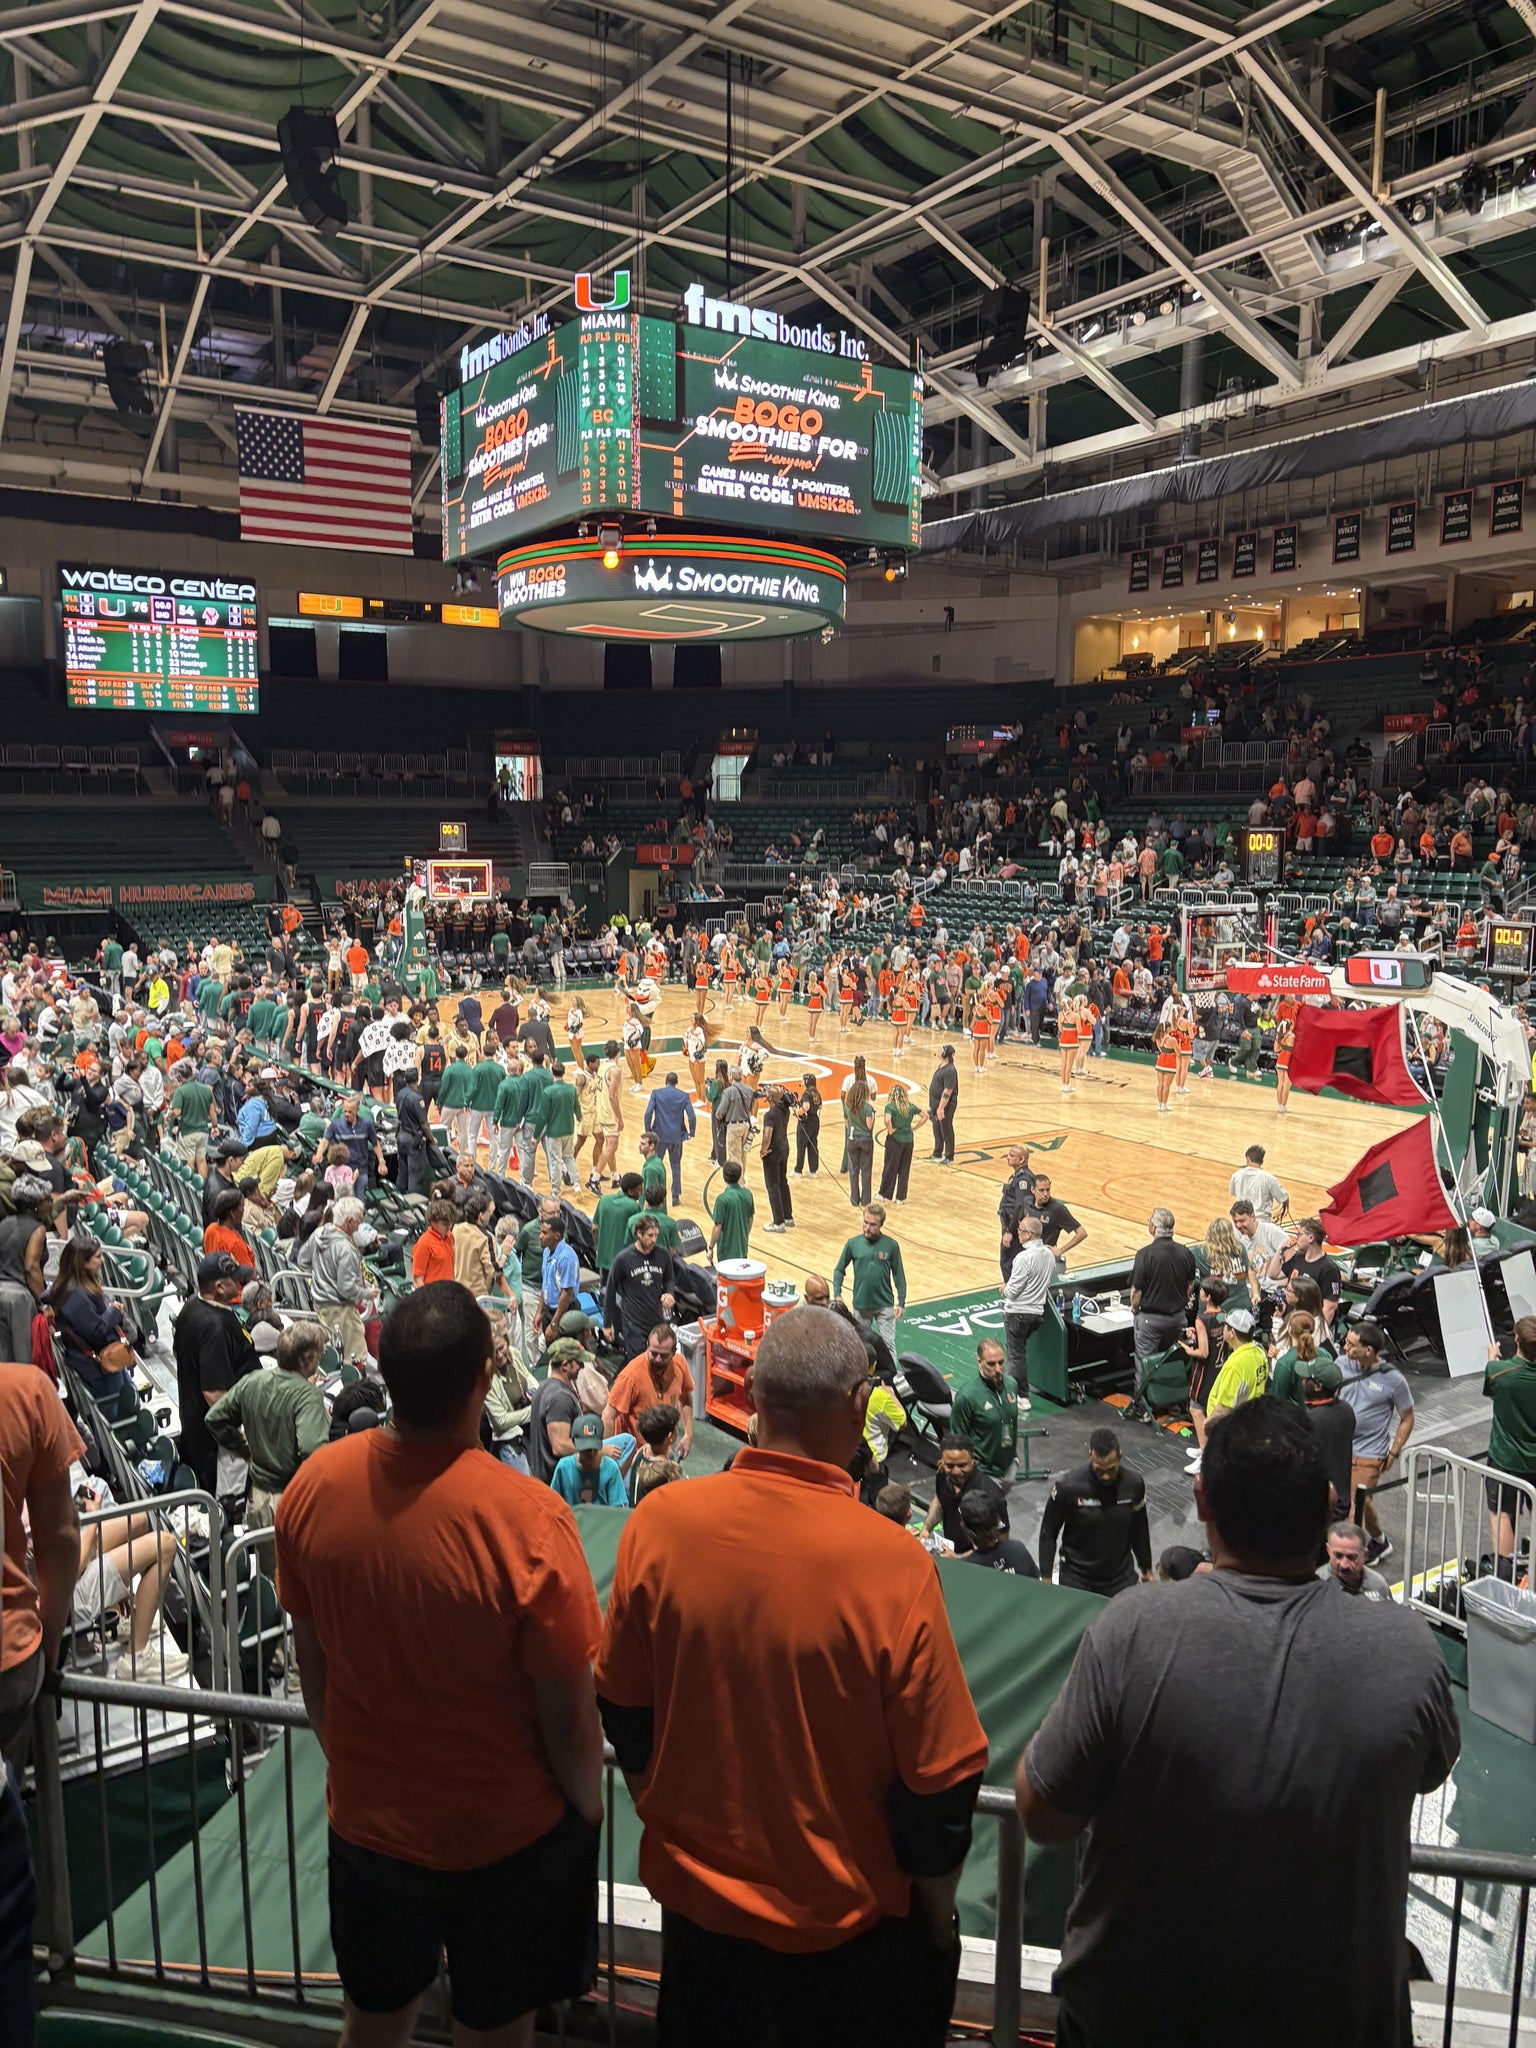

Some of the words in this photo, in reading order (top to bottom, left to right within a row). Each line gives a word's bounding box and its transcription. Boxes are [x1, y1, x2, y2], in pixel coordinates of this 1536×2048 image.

[574, 270, 631, 311] U
[533, 313, 551, 341] Inc.
[581, 313, 625, 331] MIAMI
[614, 332, 631, 343] PTS
[839, 329, 870, 361] Inc.
[599, 343, 604, 354] 1
[617, 344, 625, 354] 0
[617, 357, 626, 367] 11
[618, 370, 625, 380] 2
[598, 382, 606, 393] 0
[616, 383, 627, 393] 12
[739, 375, 806, 403] SMOOTHIE
[488, 392, 519, 418] SMOOTHIE
[617, 395, 626, 406] 4
[592, 408, 614, 424] BC
[734, 396, 823, 436] BOGO
[485, 407, 528, 453] BOGO
[615, 427, 631, 439] PTS
[599, 440, 606, 450] 2
[617, 440, 626, 451] 11
[695, 415, 811, 452] SMOOTHIES
[817, 436, 858, 461] FOR
[468, 435, 523, 478] SMOOTHIES
[525, 423, 548, 451] FOR
[599, 453, 606, 463] 0
[618, 454, 625, 464] 2
[600, 467, 606, 477] 2
[618, 467, 625, 477] 0
[701, 464, 737, 480] CANES
[739, 470, 769, 485] MADE
[772, 475, 788, 488] SIX
[617, 480, 626, 490] 11
[697, 477, 746, 499] ENTER
[749, 485, 794, 506] CODE:
[472, 498, 488, 513] CANES
[488, 492, 503, 506] MADE
[599, 493, 606, 503] 2
[470, 508, 493, 528] ENTER
[493, 499, 515, 518] CODE:
[516, 485, 548, 509] UMSK26
[1447, 504, 1468, 514] NCAA
[1391, 514, 1413, 525] WNIT
[1337, 525, 1358, 535] WNIT
[510, 571, 526, 589] WIN
[528, 564, 566, 584] BOGO
[676, 567, 781, 598] SMOOTHIE
[503, 579, 566, 608] SMOOTHIES
[132, 601, 148, 612] 76
[179, 605, 195, 616] 54
[68, 644, 76, 652] 11
[169, 650, 179, 658] 10
[66, 652, 78, 660] 14
[43, 885, 112, 905] MIAMI
[120, 882, 255, 904] HURRICANES
[1374, 964, 1397, 980] U
[1467, 1013, 1498, 1043] SPALDING
[429, 1057, 442, 1071] 14
